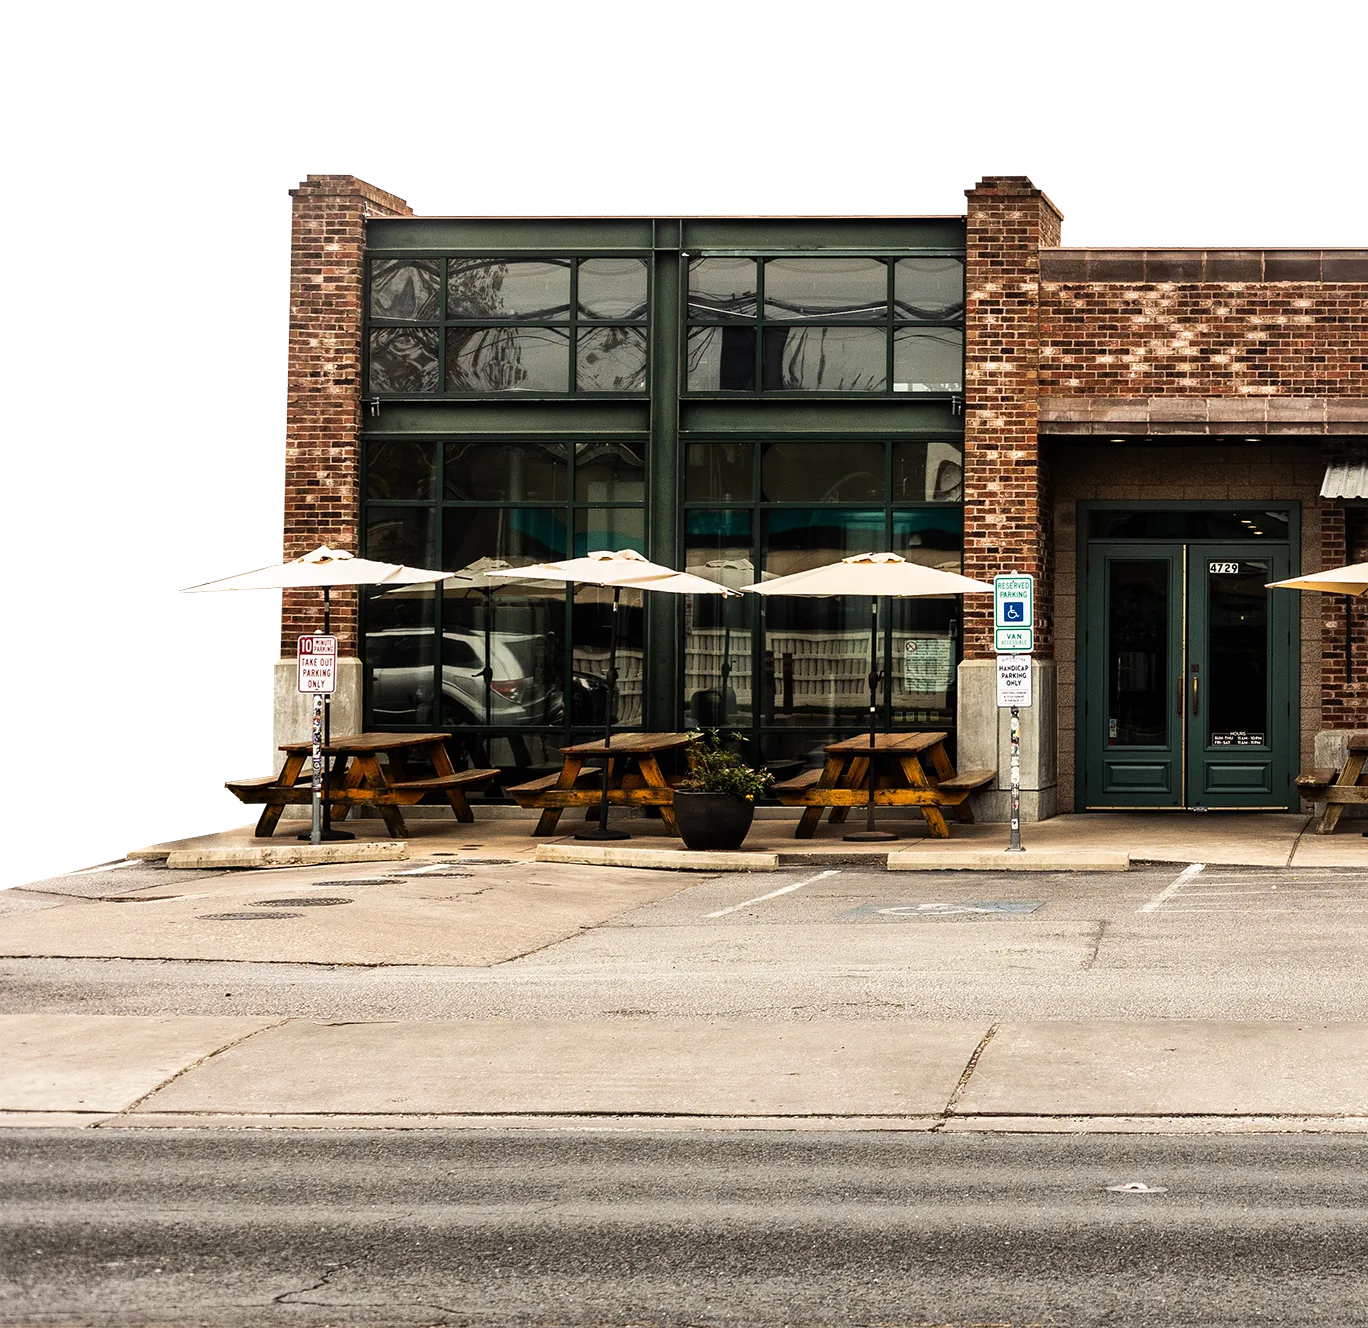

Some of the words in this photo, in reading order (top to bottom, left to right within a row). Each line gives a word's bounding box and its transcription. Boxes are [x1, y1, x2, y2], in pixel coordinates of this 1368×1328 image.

[1210, 564, 1238, 573] 4729
[301, 639, 312, 653] 10
[302, 658, 317, 666] TAKE
[320, 658, 333, 666] OUT
[303, 669, 331, 677] PARKING
[308, 680, 325, 688] ONLY
